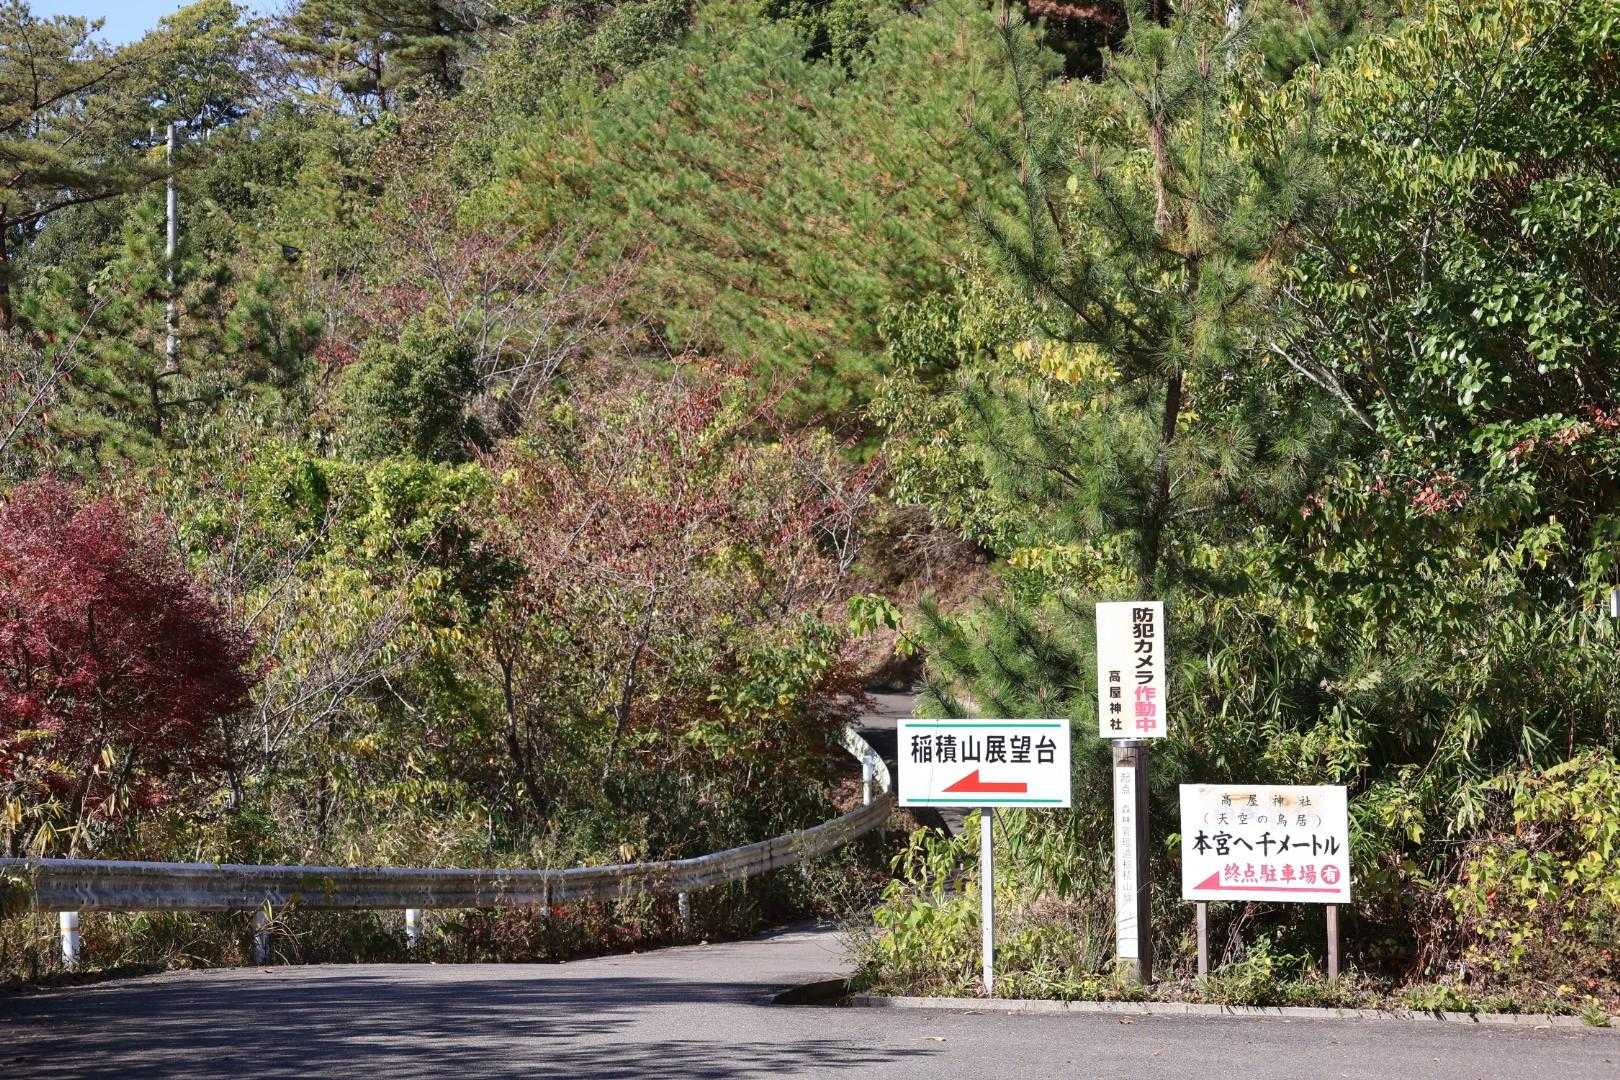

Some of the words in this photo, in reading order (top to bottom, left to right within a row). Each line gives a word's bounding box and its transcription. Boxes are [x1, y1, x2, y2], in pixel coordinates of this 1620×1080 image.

[1132, 607, 1157, 733] 防犯カメラ作動中
[1109, 670, 1123, 731] 高屋神社
[911, 735, 1057, 764] 稲積山展望台
[1192, 830, 1341, 857] 本宮へ千メートル
